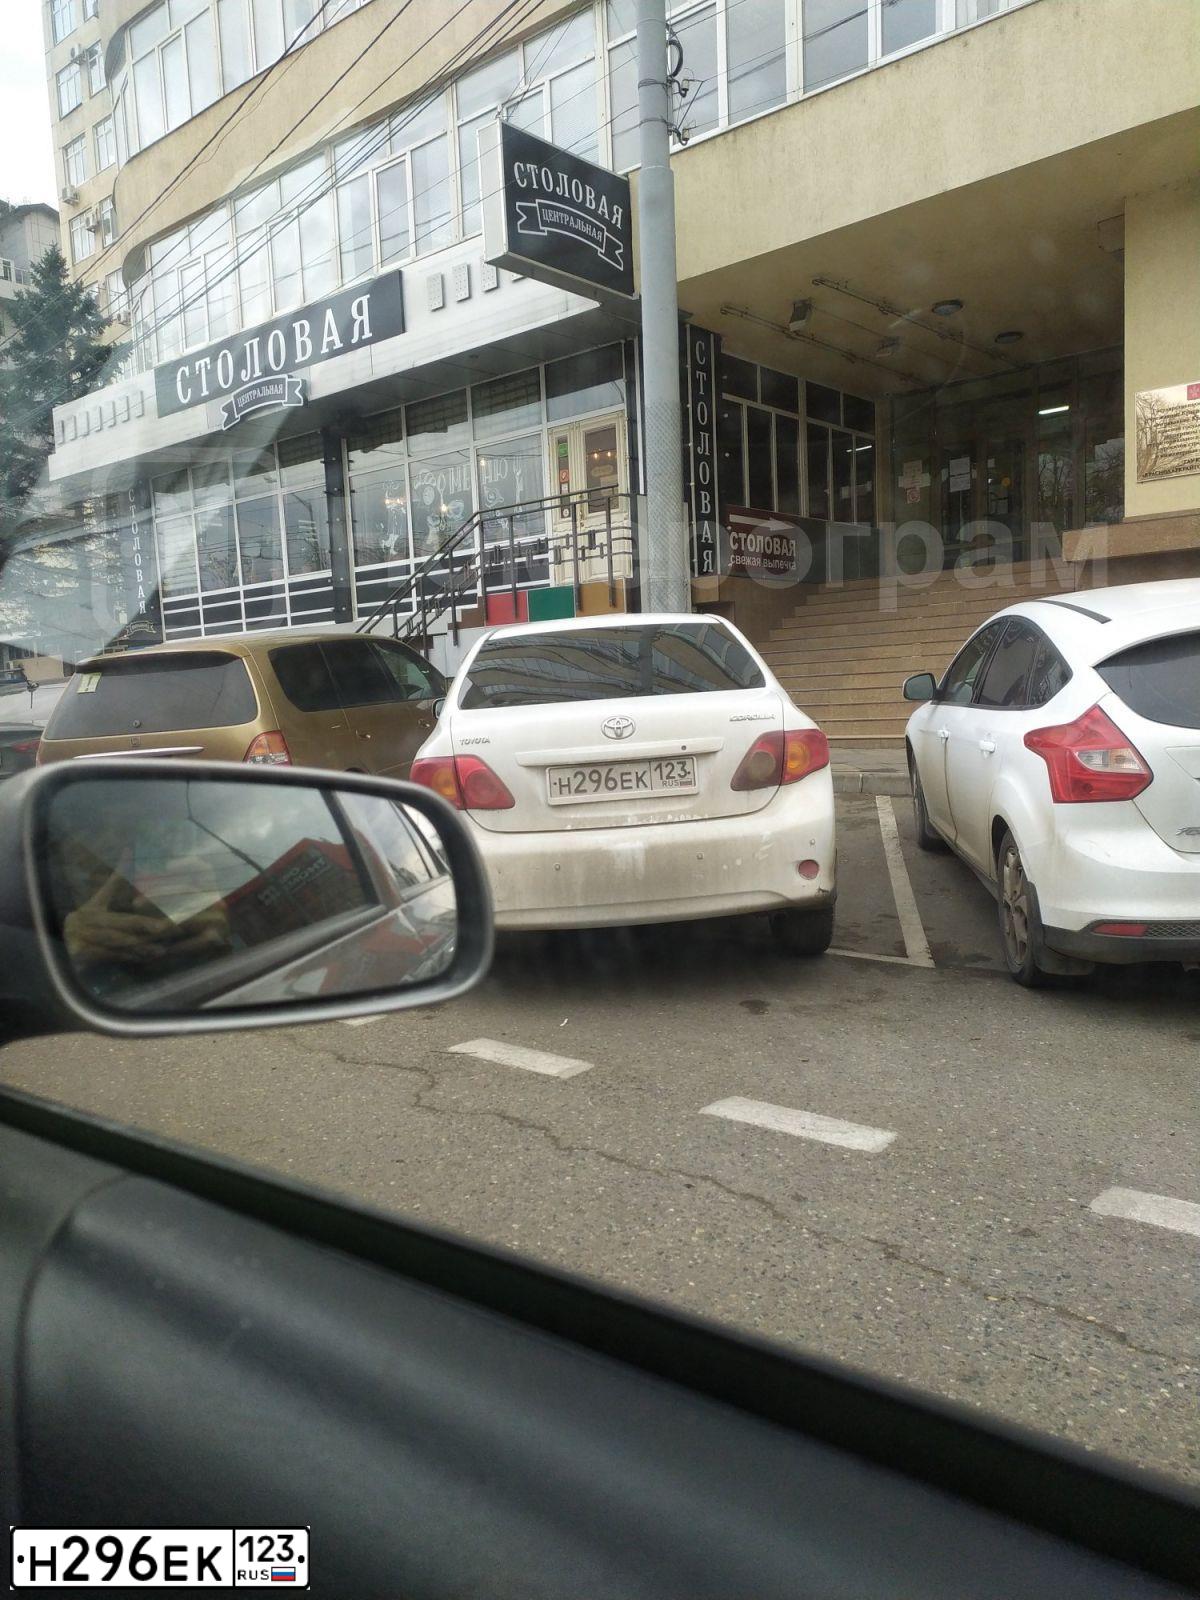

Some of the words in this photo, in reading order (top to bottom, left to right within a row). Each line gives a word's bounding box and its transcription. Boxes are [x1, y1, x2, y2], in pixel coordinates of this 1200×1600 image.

[513, 161, 624, 230] СТОЛОВАЯ
[541, 208, 603, 243] ЦЕНТРАЛЬНАЯ
[176, 294, 373, 404] СТОЛОВАЯ
[236, 383, 284, 408] ЦЕНТРАЛЬНАЯ
[695, 340, 714, 573] СТОЛОВАЯ
[128, 488, 147, 615] СТОЛОВАЯ
[729, 531, 797, 557] СТОЛОВАЯ
[730, 554, 761, 568] свежая
[763, 557, 797, 570] выпечка
[459, 736, 491, 746] TOYOTA
[654, 760, 688, 780] 123
[661, 779, 679, 787] RUS
